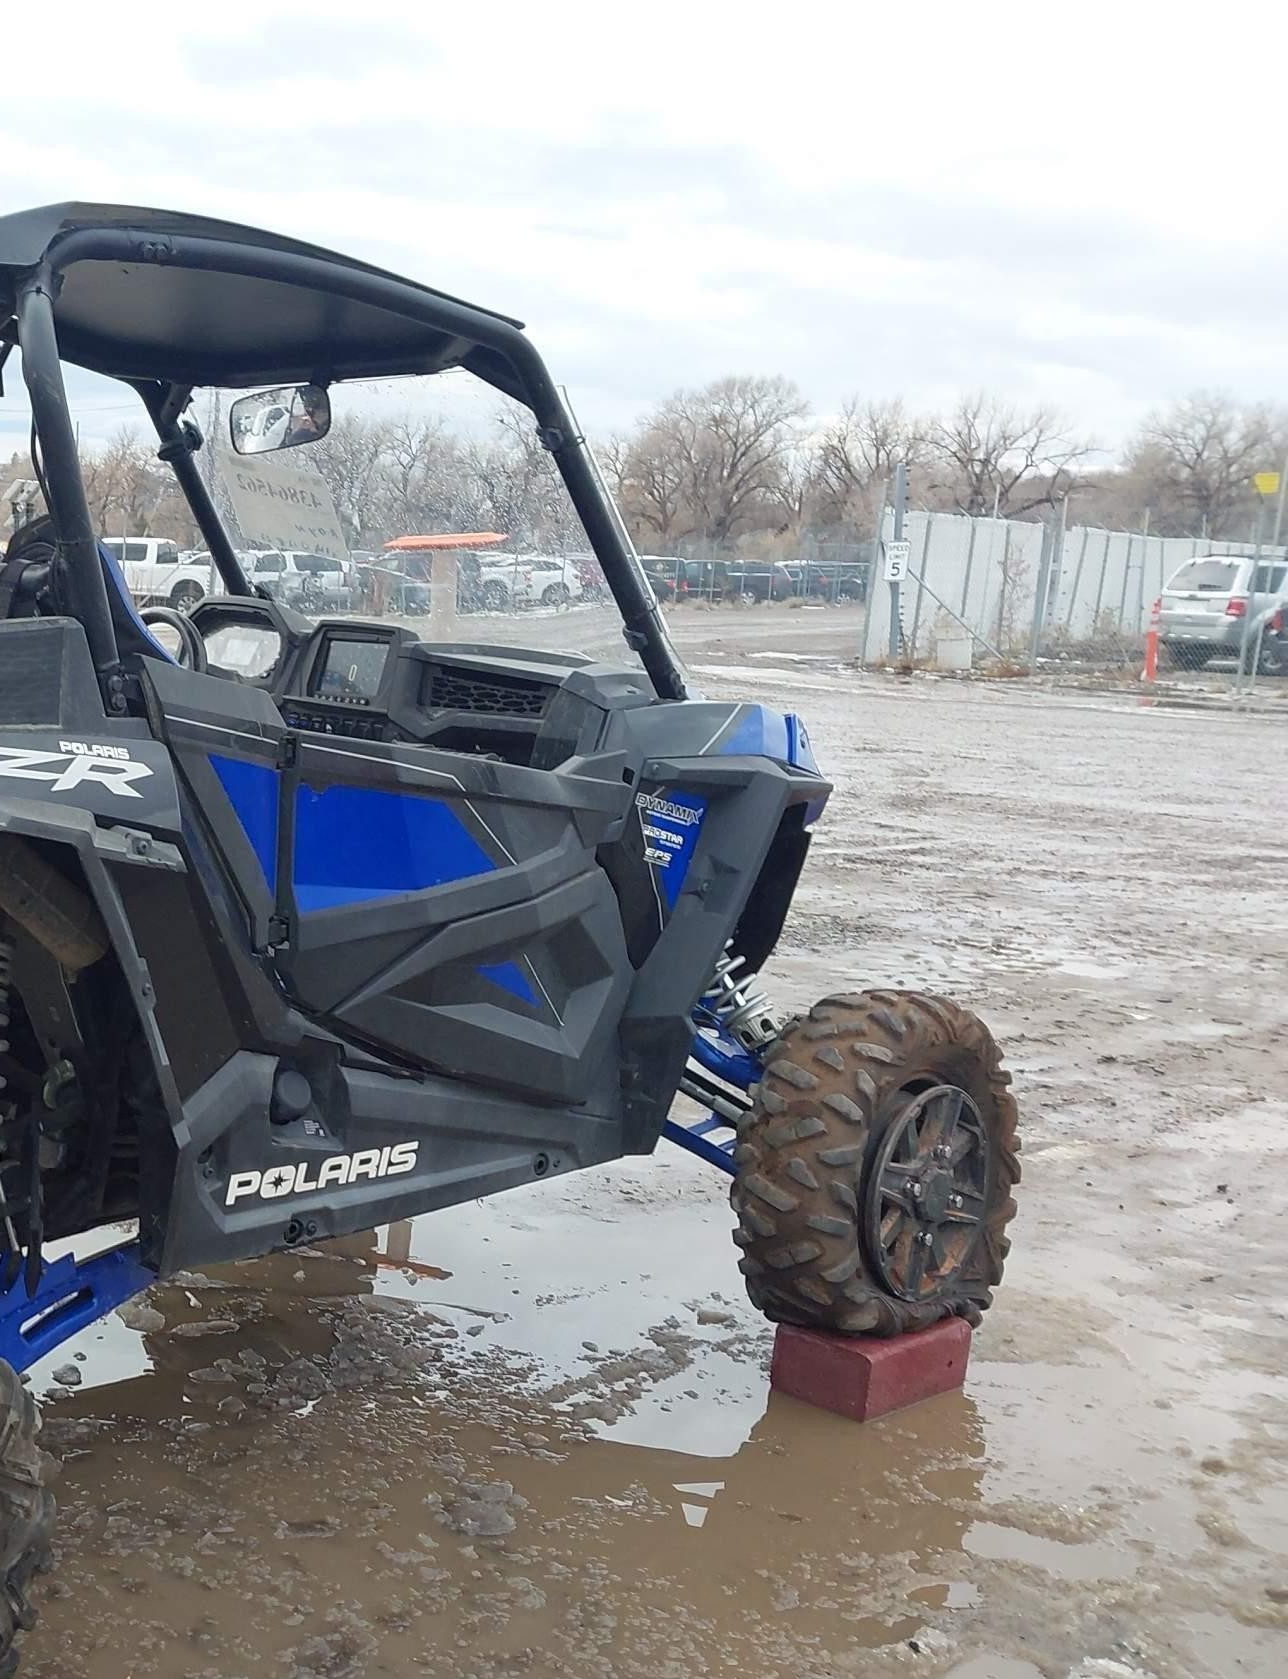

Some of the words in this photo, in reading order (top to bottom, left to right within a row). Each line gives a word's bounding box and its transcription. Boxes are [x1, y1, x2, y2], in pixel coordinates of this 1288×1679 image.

[891, 562, 900, 577] 5
[58, 740, 130, 760] POLARIS
[644, 847, 673, 862] EPS
[225, 1141, 420, 1206] POLARIS
